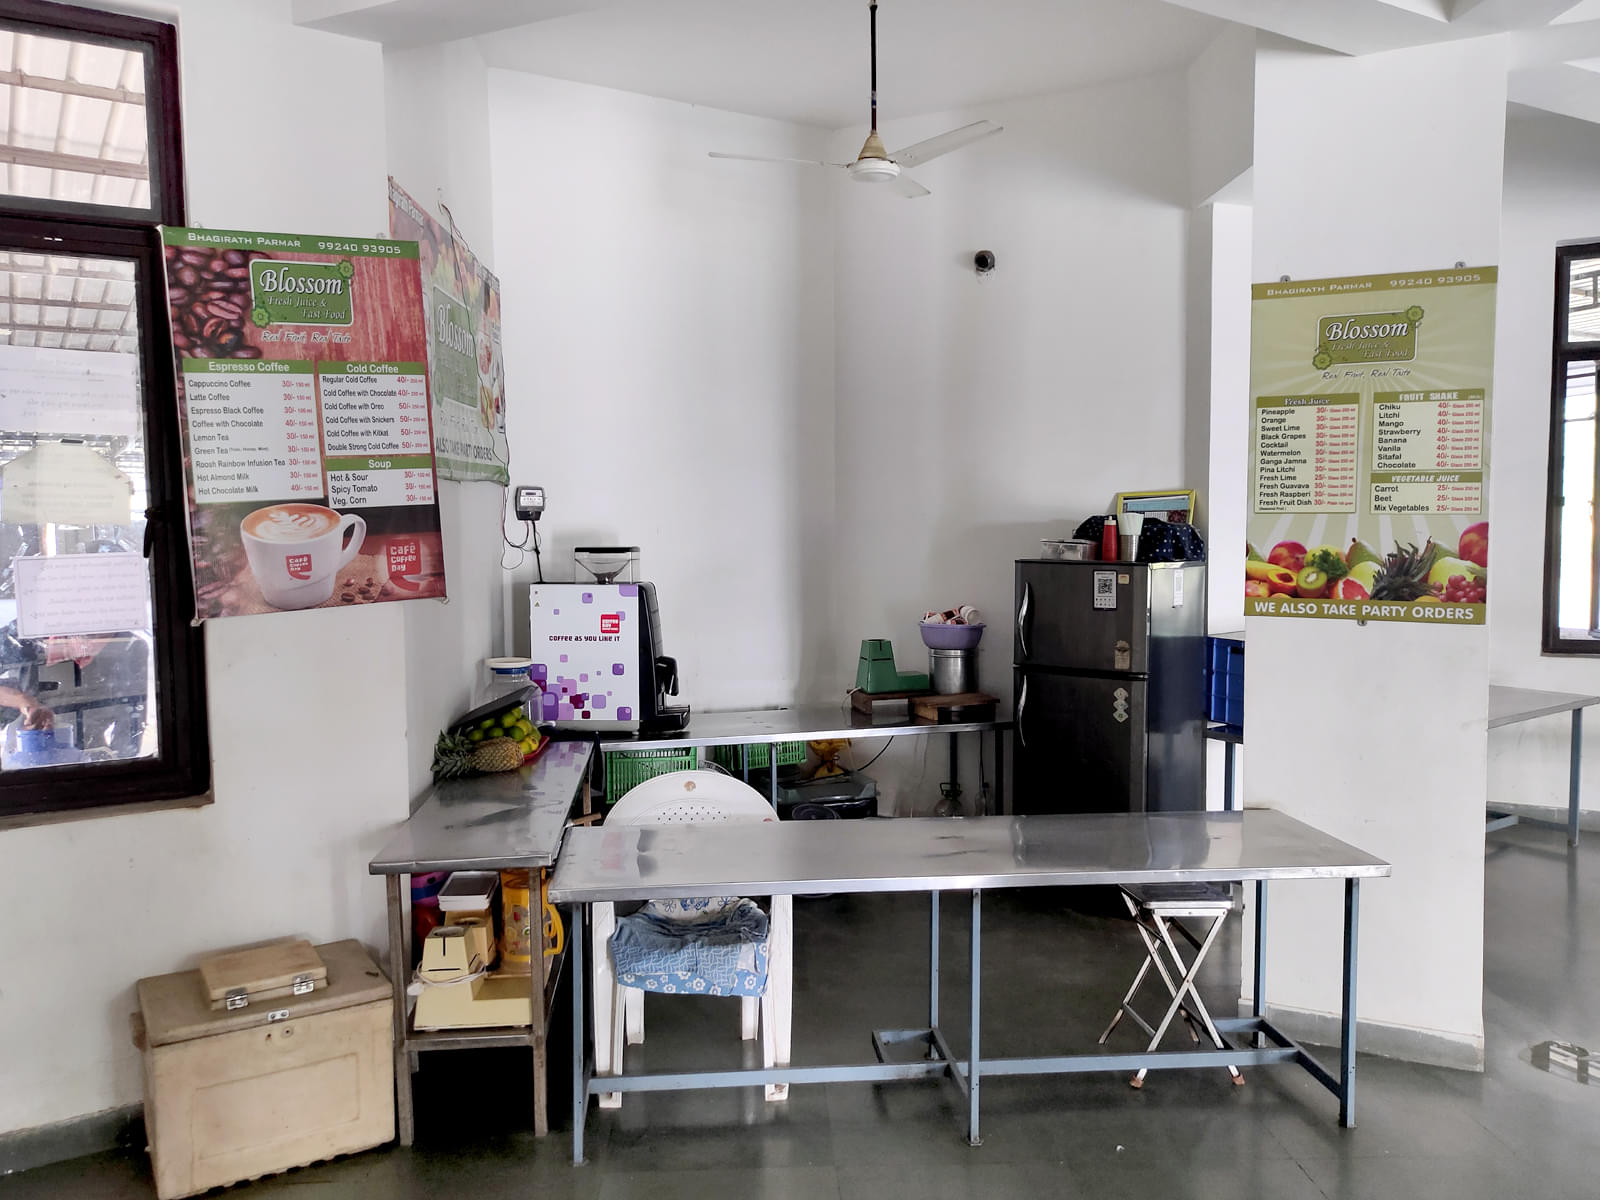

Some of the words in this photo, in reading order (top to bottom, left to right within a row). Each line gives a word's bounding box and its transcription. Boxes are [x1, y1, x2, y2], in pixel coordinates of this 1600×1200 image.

[318, 242, 359, 252] 99240
[363, 244, 401, 255] 93905
[260, 268, 343, 295] Blossom
[1390, 278, 1432, 287] 99240
[1438, 274, 1481, 283] 93905
[268, 296, 292, 305] Fresh
[320, 299, 327, 307] &
[438, 305, 474, 359] Blossom
[1325, 320, 1408, 341] Blossom
[262, 331, 280, 342] Real
[312, 332, 330, 344] Real
[209, 362, 256, 372] Espresso
[258, 362, 289, 372] Coffee
[347, 364, 368, 373] Cold
[370, 364, 399, 373] Coffee
[1371, 369, 1389, 378] Real
[189, 380, 228, 388] Cappuccino
[322, 376, 344, 384] Regular
[1400, 393, 1424, 401] FRUIT
[1430, 392, 1458, 400] SHAKE
[191, 407, 221, 415] Espresso
[192, 420, 214, 428] Coffee
[368, 460, 392, 469] Soup
[331, 474, 343, 482] Hot
[352, 473, 368, 481] Sour
[212, 487, 245, 495] Chocolate
[332, 486, 351, 494] Spicy
[332, 497, 348, 506] Veg.
[1255, 601, 1276, 613] WE
[1280, 602, 1318, 615] ALSO
[1322, 604, 1356, 615] TAKE
[1362, 605, 1407, 617] PARTY
[1412, 606, 1474, 619] ORDERS
